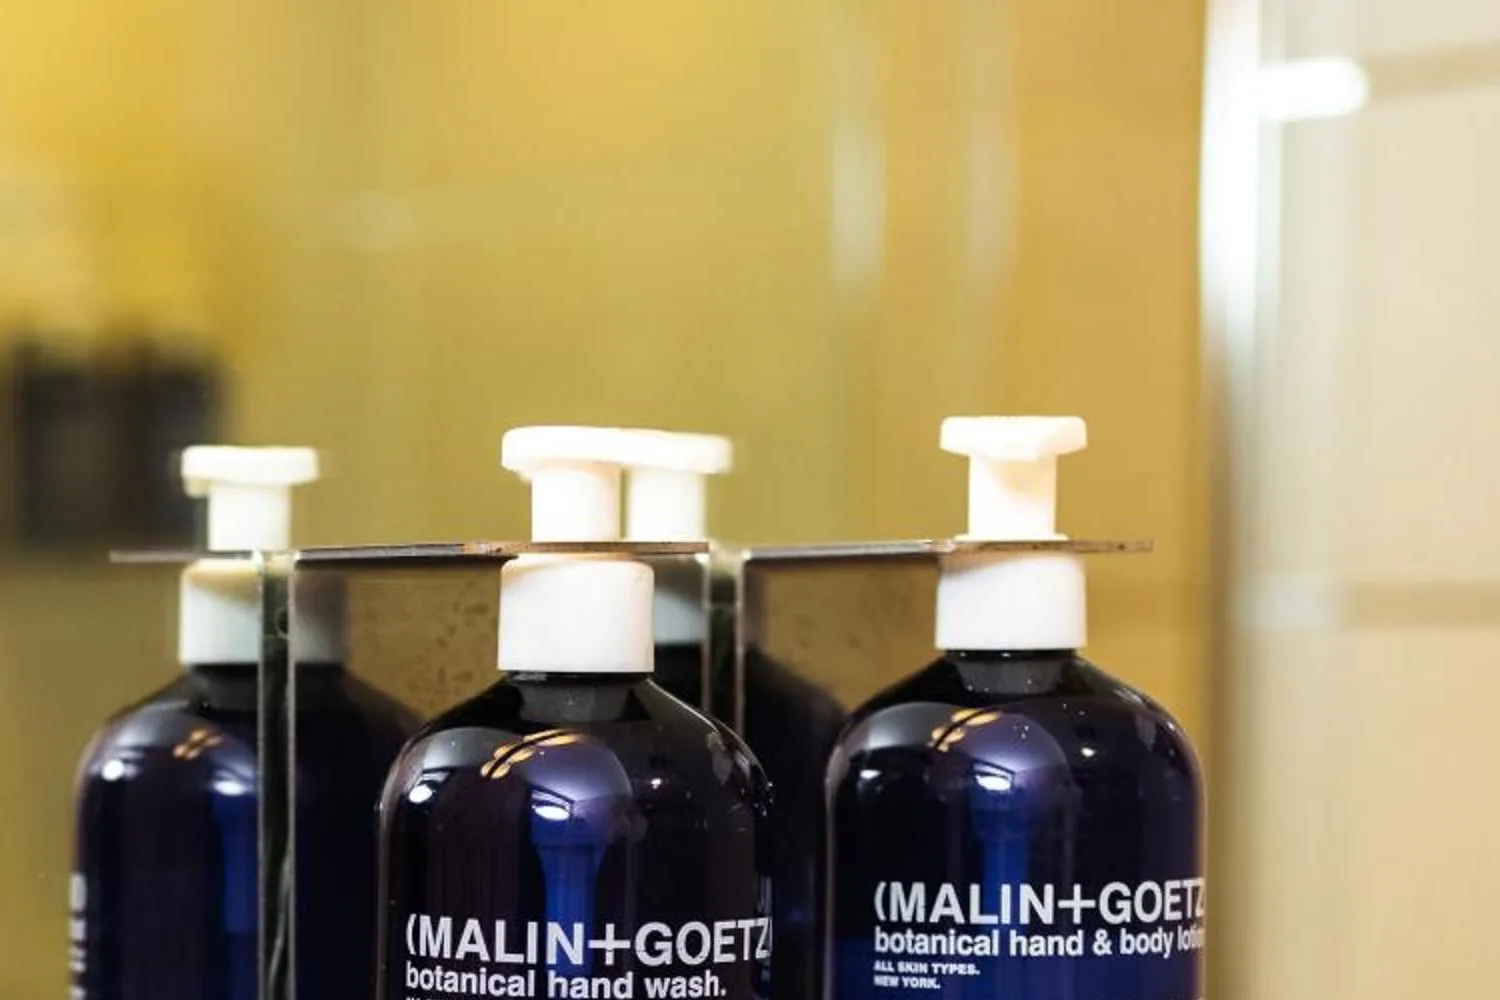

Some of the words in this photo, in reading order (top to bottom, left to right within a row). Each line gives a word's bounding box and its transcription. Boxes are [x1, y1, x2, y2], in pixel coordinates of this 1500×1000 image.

[875, 926, 999, 956] botanical
[1010, 929, 1082, 956] hand
[1092, 931, 1112, 955] &
[1120, 926, 1174, 958] body
[874, 960, 894, 973] ALL
[898, 961, 928, 974] SKIN
[932, 962, 980, 975] TYPES.
[406, 960, 535, 997] botanical
[547, 969, 634, 999] hand
[644, 969, 727, 998] wash.
[874, 975, 899, 987] NEW
[903, 976, 940, 989] YORK.
